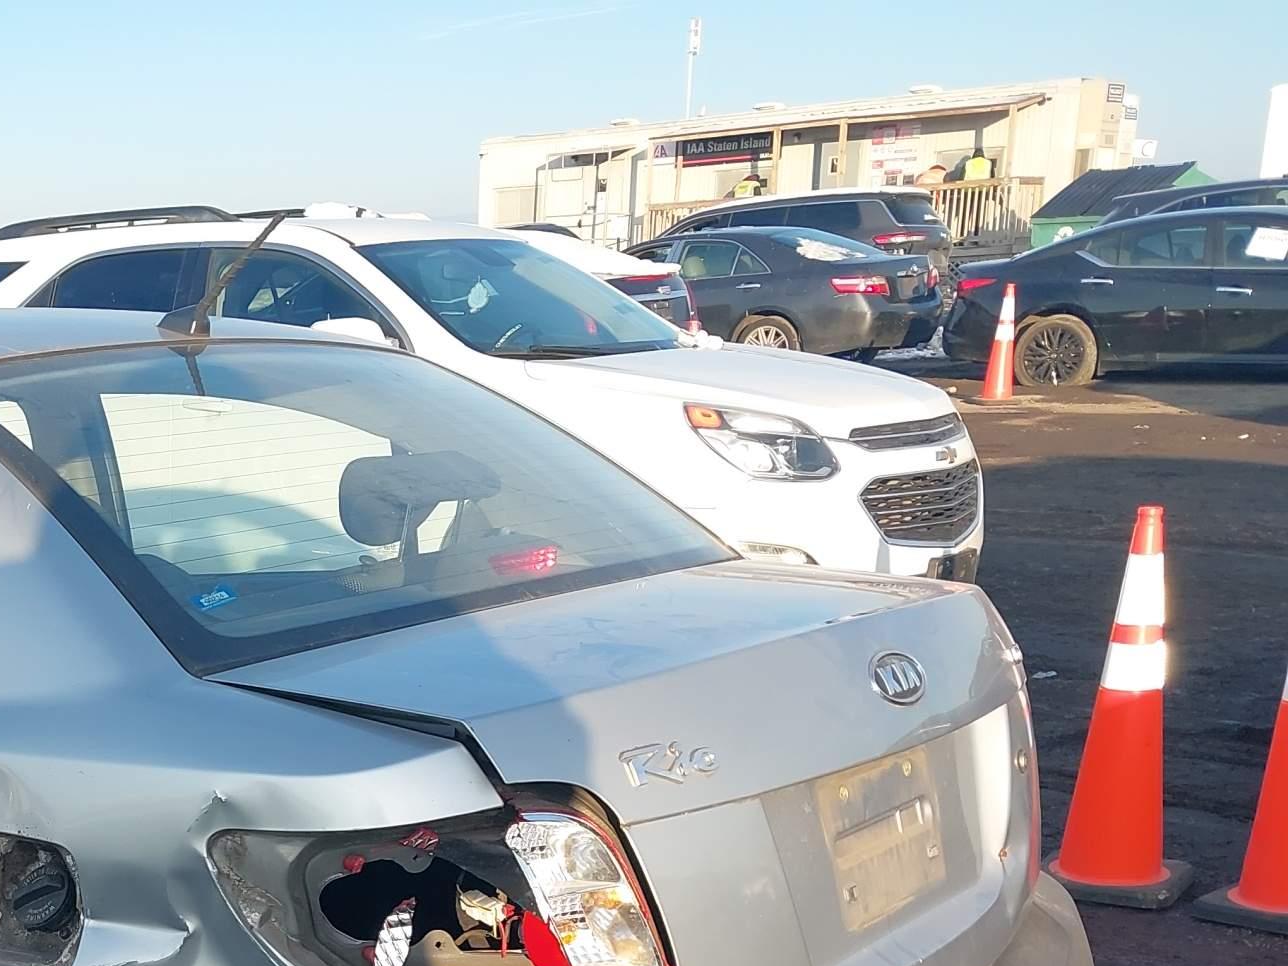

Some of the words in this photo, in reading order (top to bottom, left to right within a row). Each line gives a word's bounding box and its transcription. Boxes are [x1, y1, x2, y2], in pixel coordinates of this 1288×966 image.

[687, 141, 705, 155] IAA
[707, 139, 738, 153] Staten
[740, 136, 771, 150] Island
[875, 660, 921, 696] KIA
[618, 740, 721, 788] Rio
